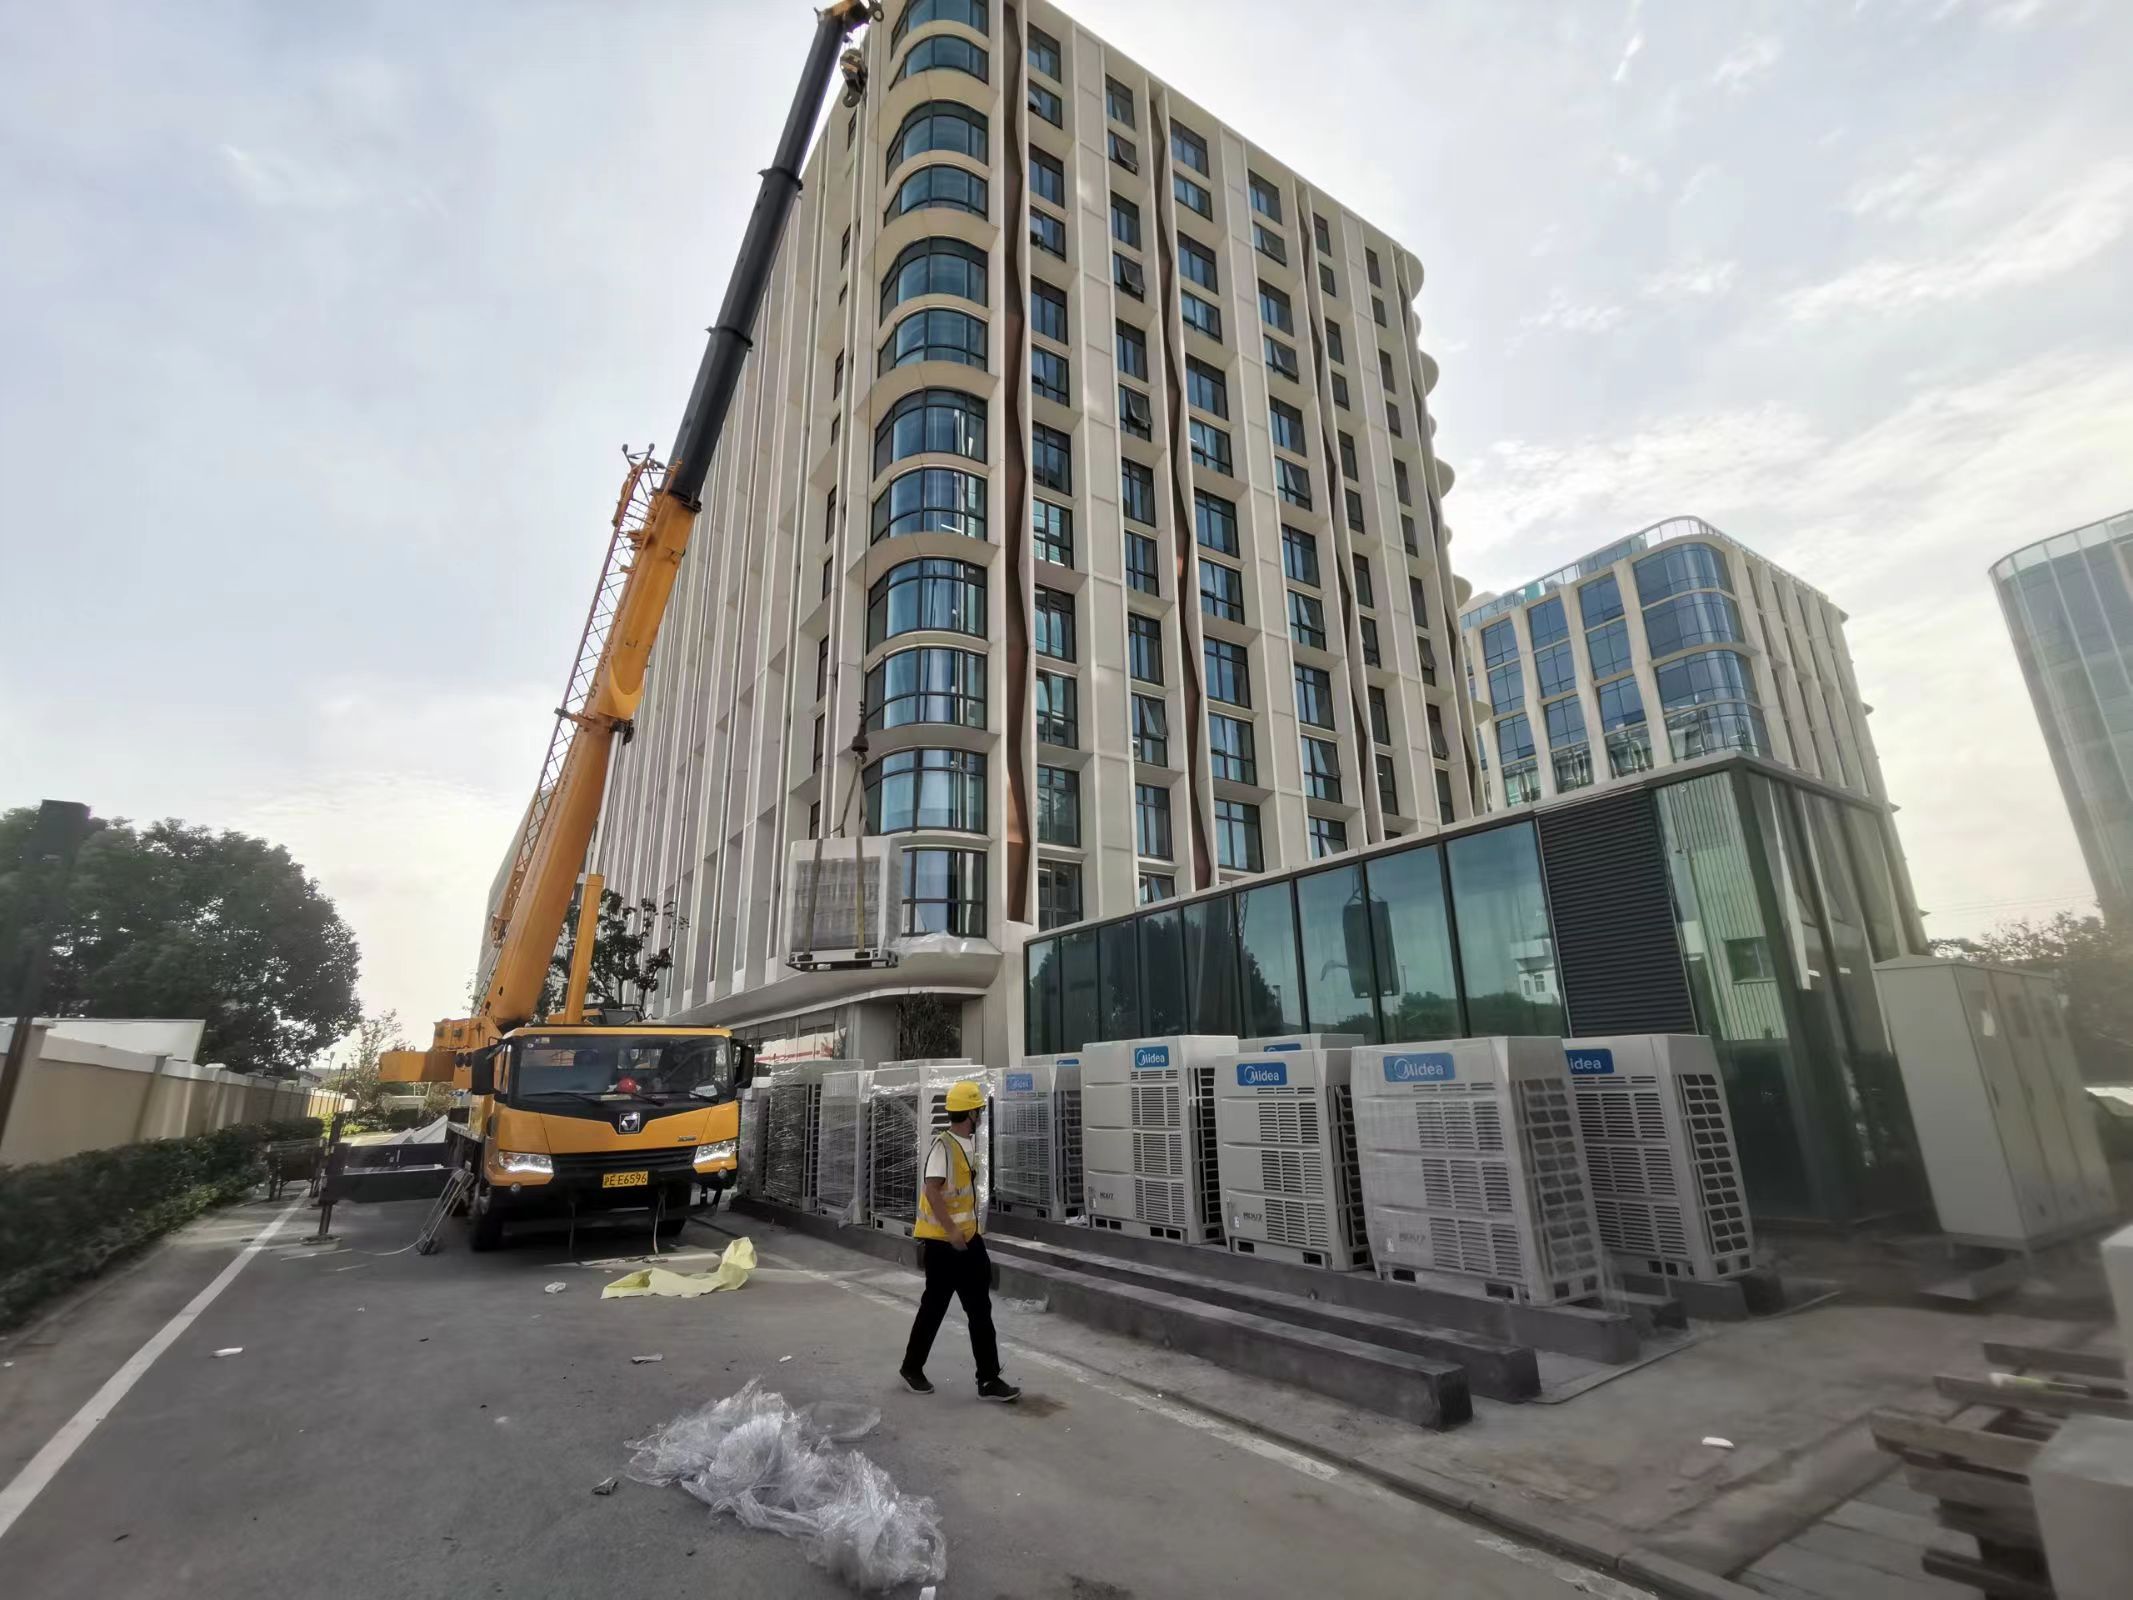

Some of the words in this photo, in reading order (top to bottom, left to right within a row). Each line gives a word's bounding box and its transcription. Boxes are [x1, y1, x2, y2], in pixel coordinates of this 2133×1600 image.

[1136, 1049, 1165, 1066] Midea
[1570, 1057, 1602, 1070] idea
[1244, 1065, 1280, 1084] Midea
[1394, 1058, 1444, 1079] Midea
